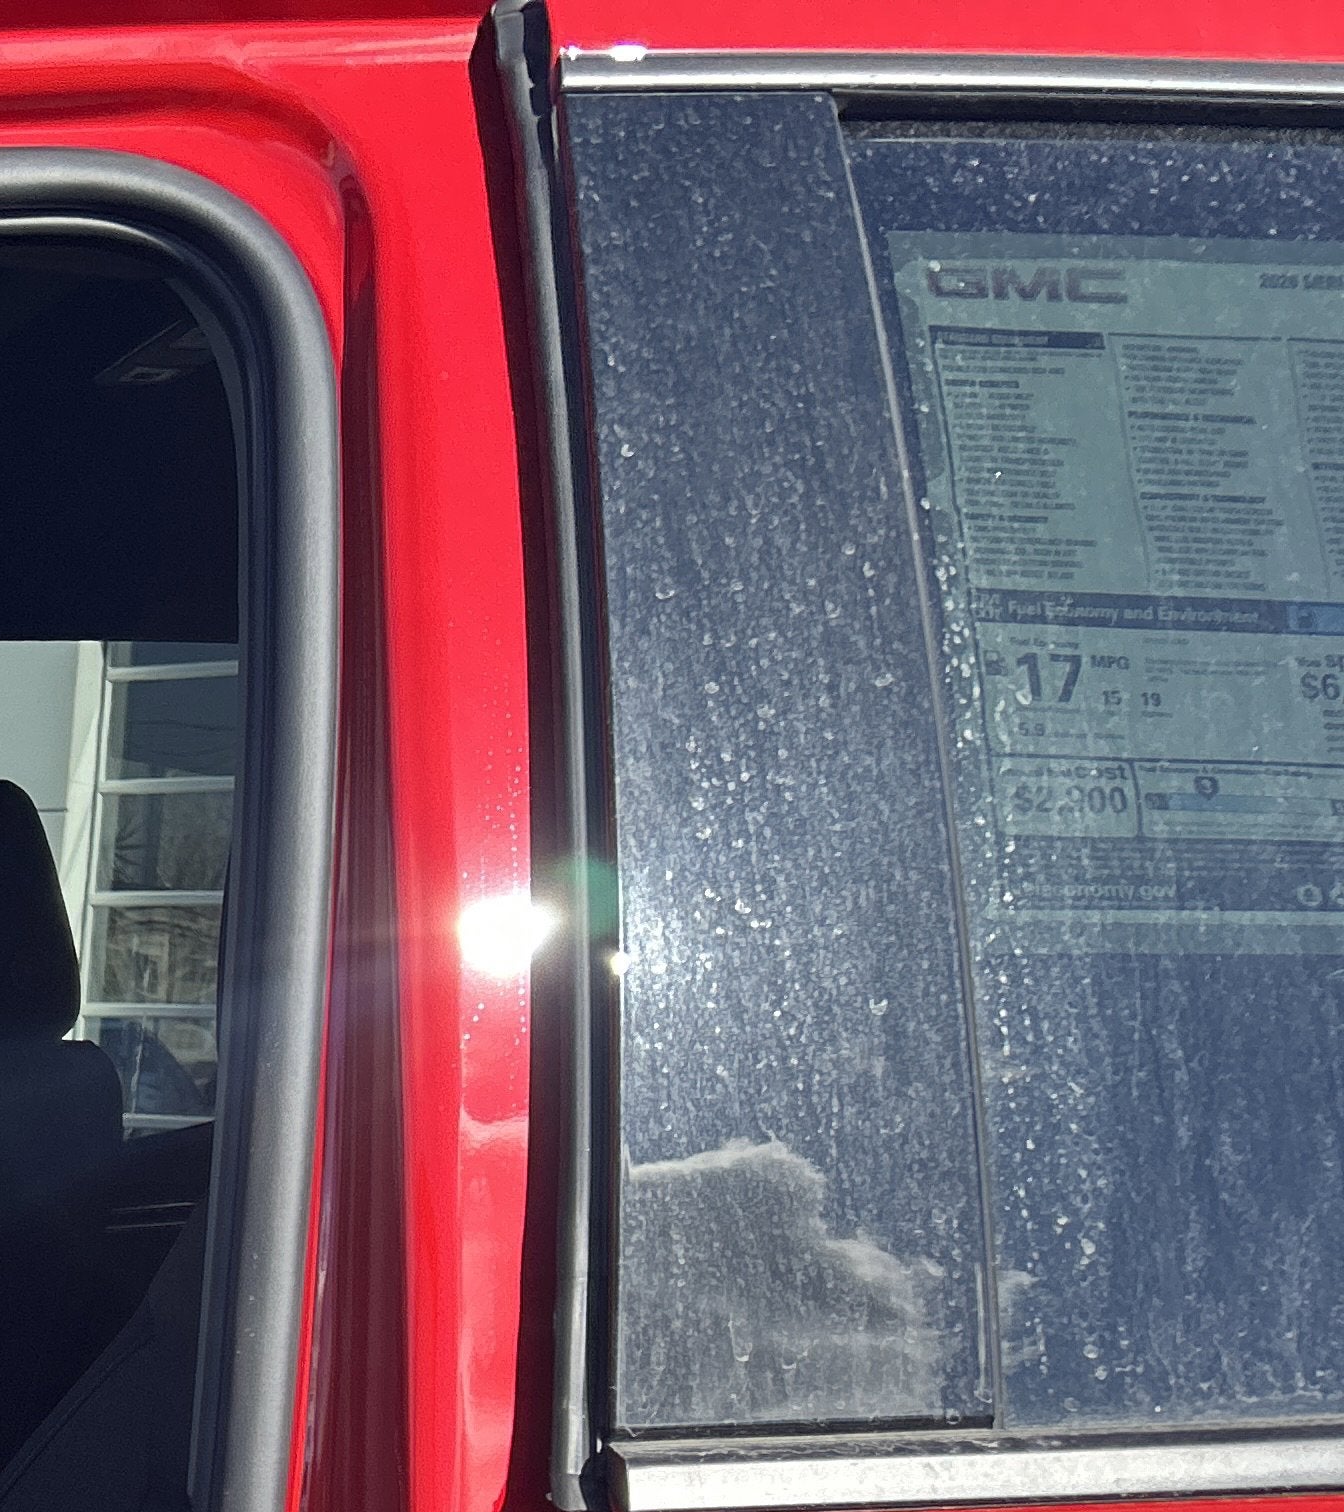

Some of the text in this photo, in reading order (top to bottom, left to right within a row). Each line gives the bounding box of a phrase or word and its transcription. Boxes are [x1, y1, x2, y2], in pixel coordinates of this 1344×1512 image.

[927, 267, 1128, 304] GMC
[1008, 599, 1043, 617] Fuel
[1123, 605, 1154, 621] and
[1090, 654, 1130, 670] MPG
[1016, 652, 1082, 703] 17
[1102, 689, 1162, 707] 15 19
